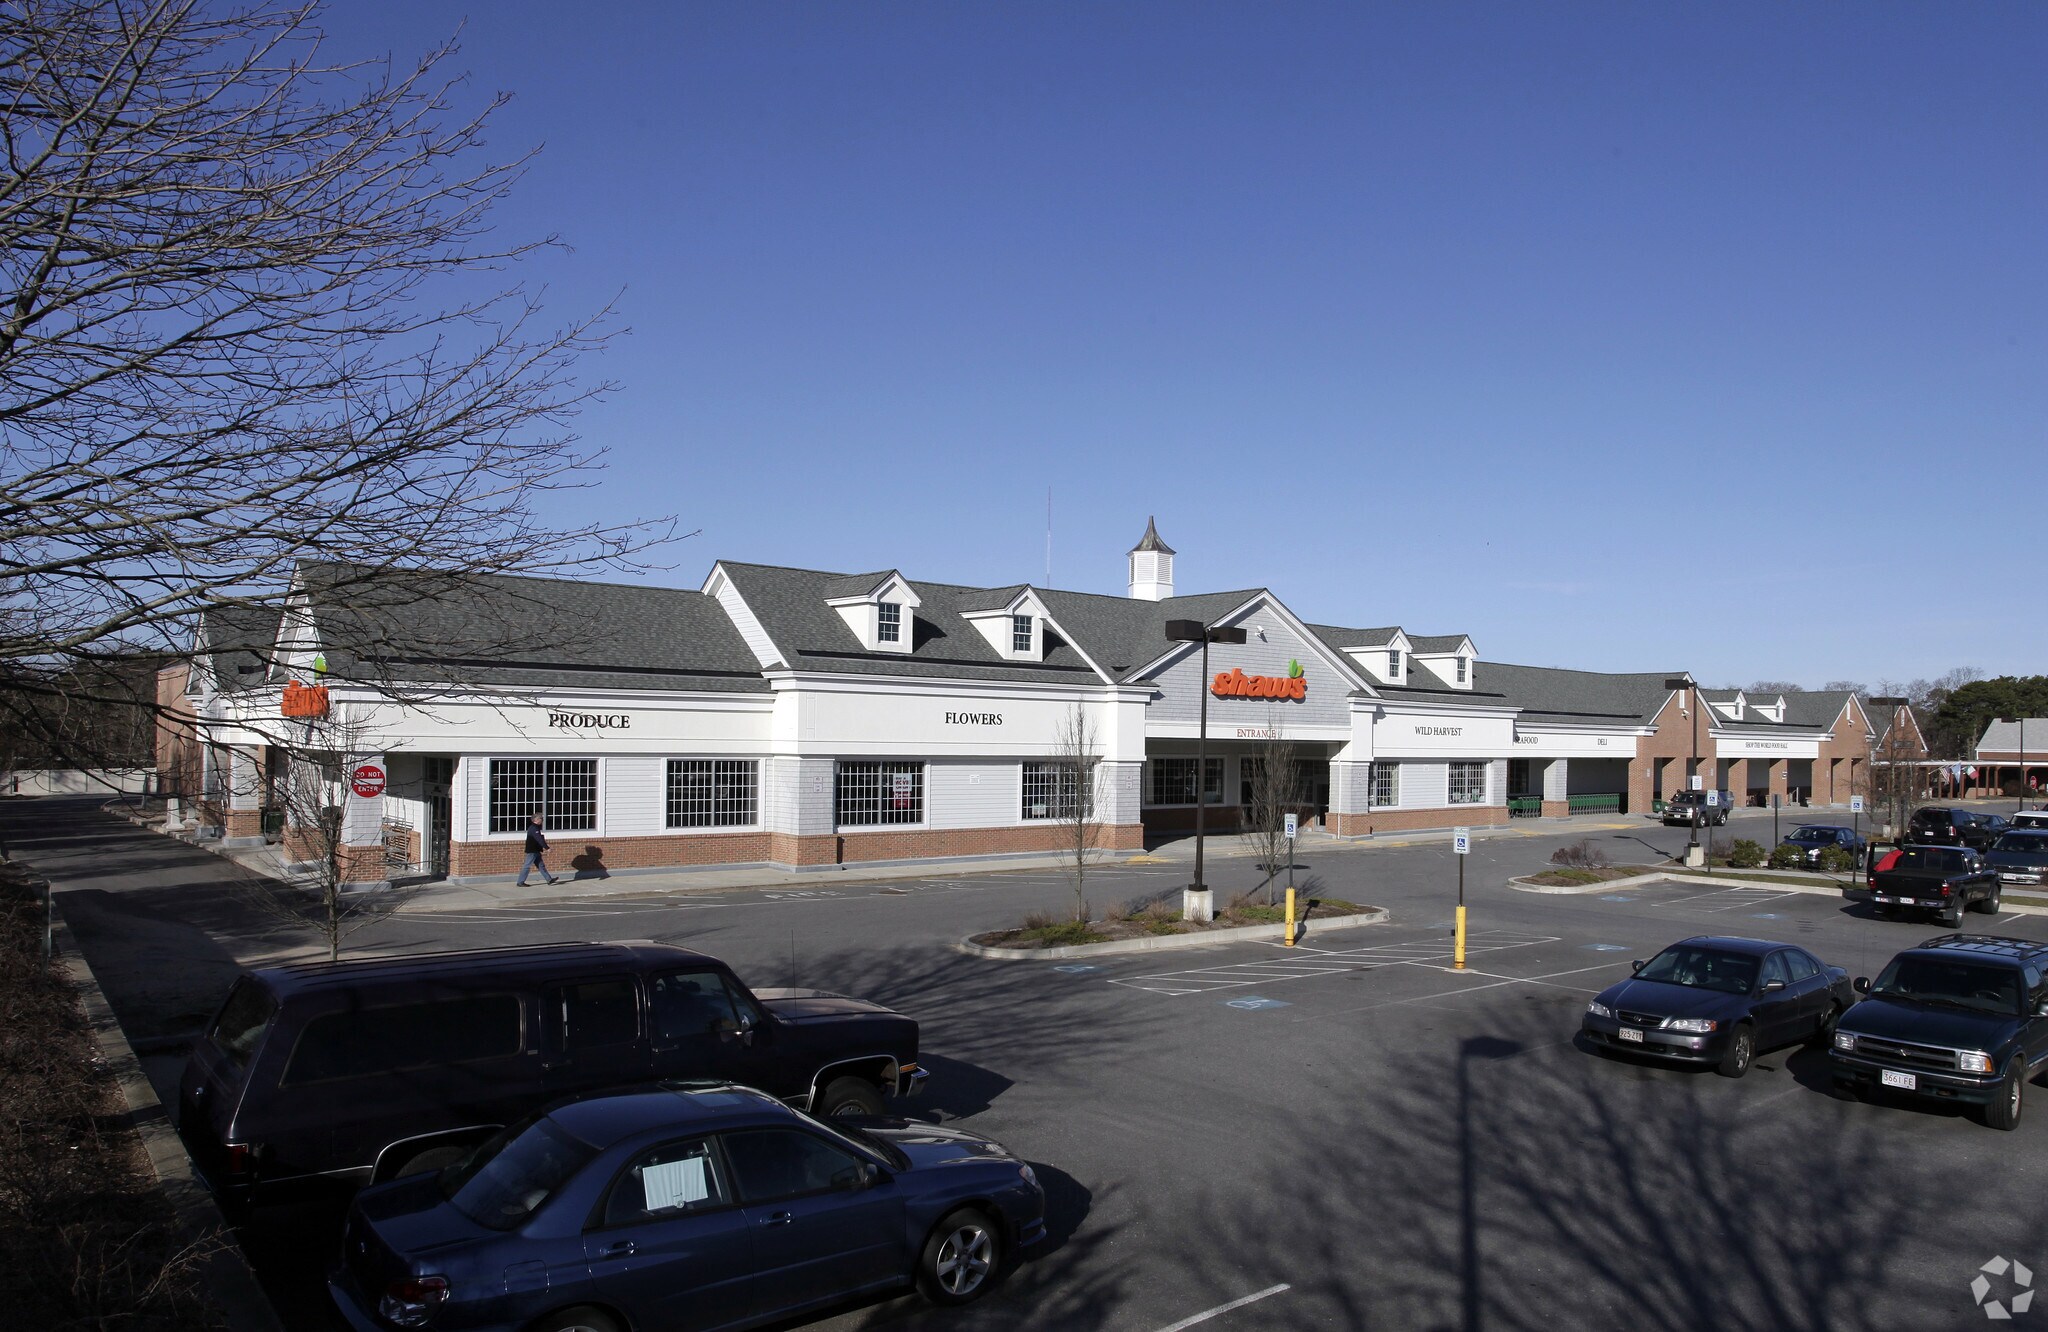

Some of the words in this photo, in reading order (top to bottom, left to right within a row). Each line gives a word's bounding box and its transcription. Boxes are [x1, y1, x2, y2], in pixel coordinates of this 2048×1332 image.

[548, 713, 631, 728] PRODUCE
[945, 711, 1003, 726] FLOWERS
[1237, 728, 1276, 738] ENTRANCE
[1415, 726, 1432, 736] WILD
[1433, 726, 1463, 736] HARVEST
[1597, 738, 1608, 746] DELI
